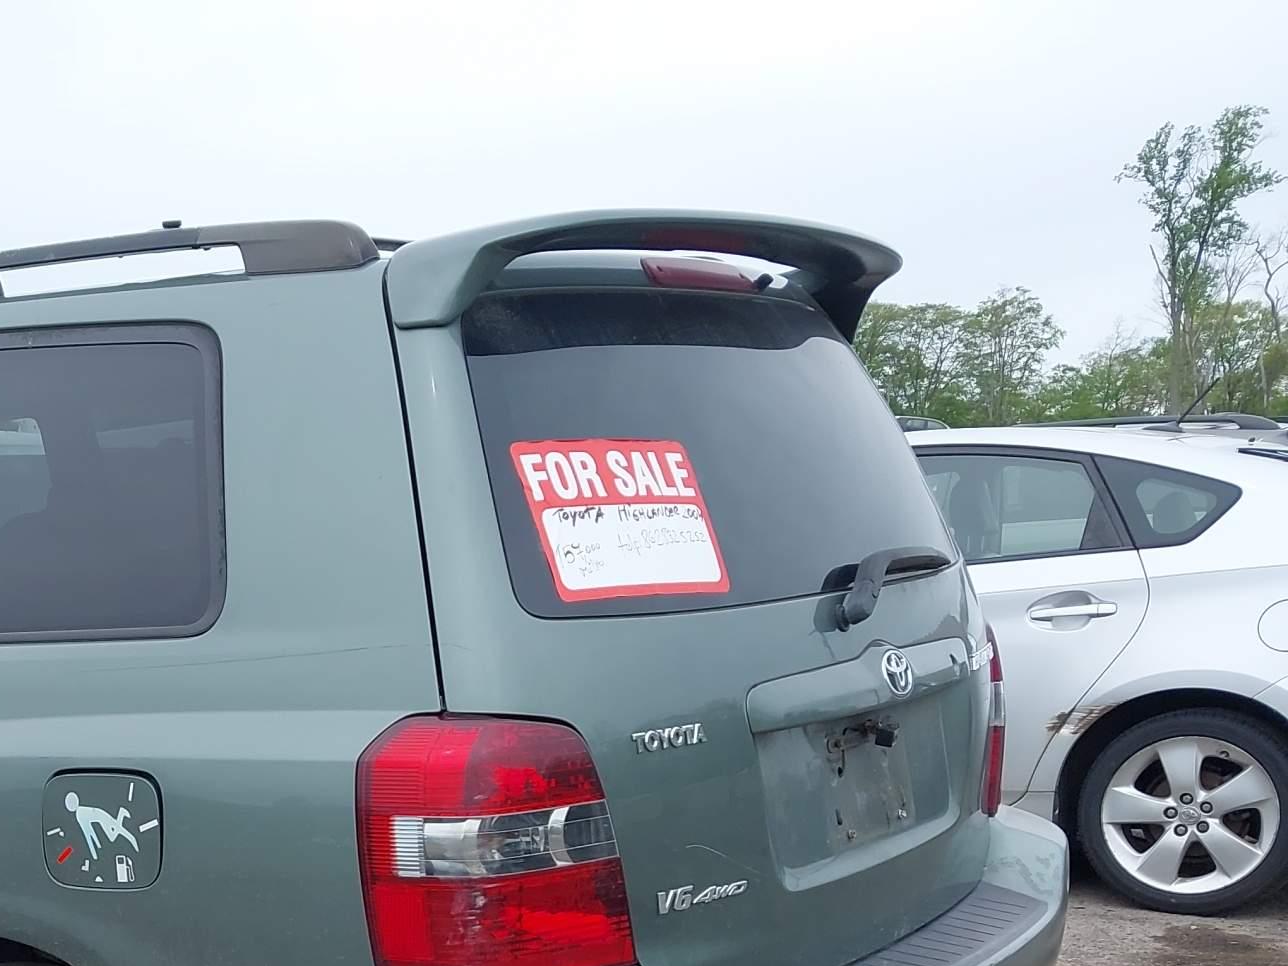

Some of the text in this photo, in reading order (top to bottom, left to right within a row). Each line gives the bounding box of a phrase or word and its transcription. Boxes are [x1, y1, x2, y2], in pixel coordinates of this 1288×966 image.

[519, 450, 696, 501] FOR SALE
[631, 722, 708, 755] TOYOTA
